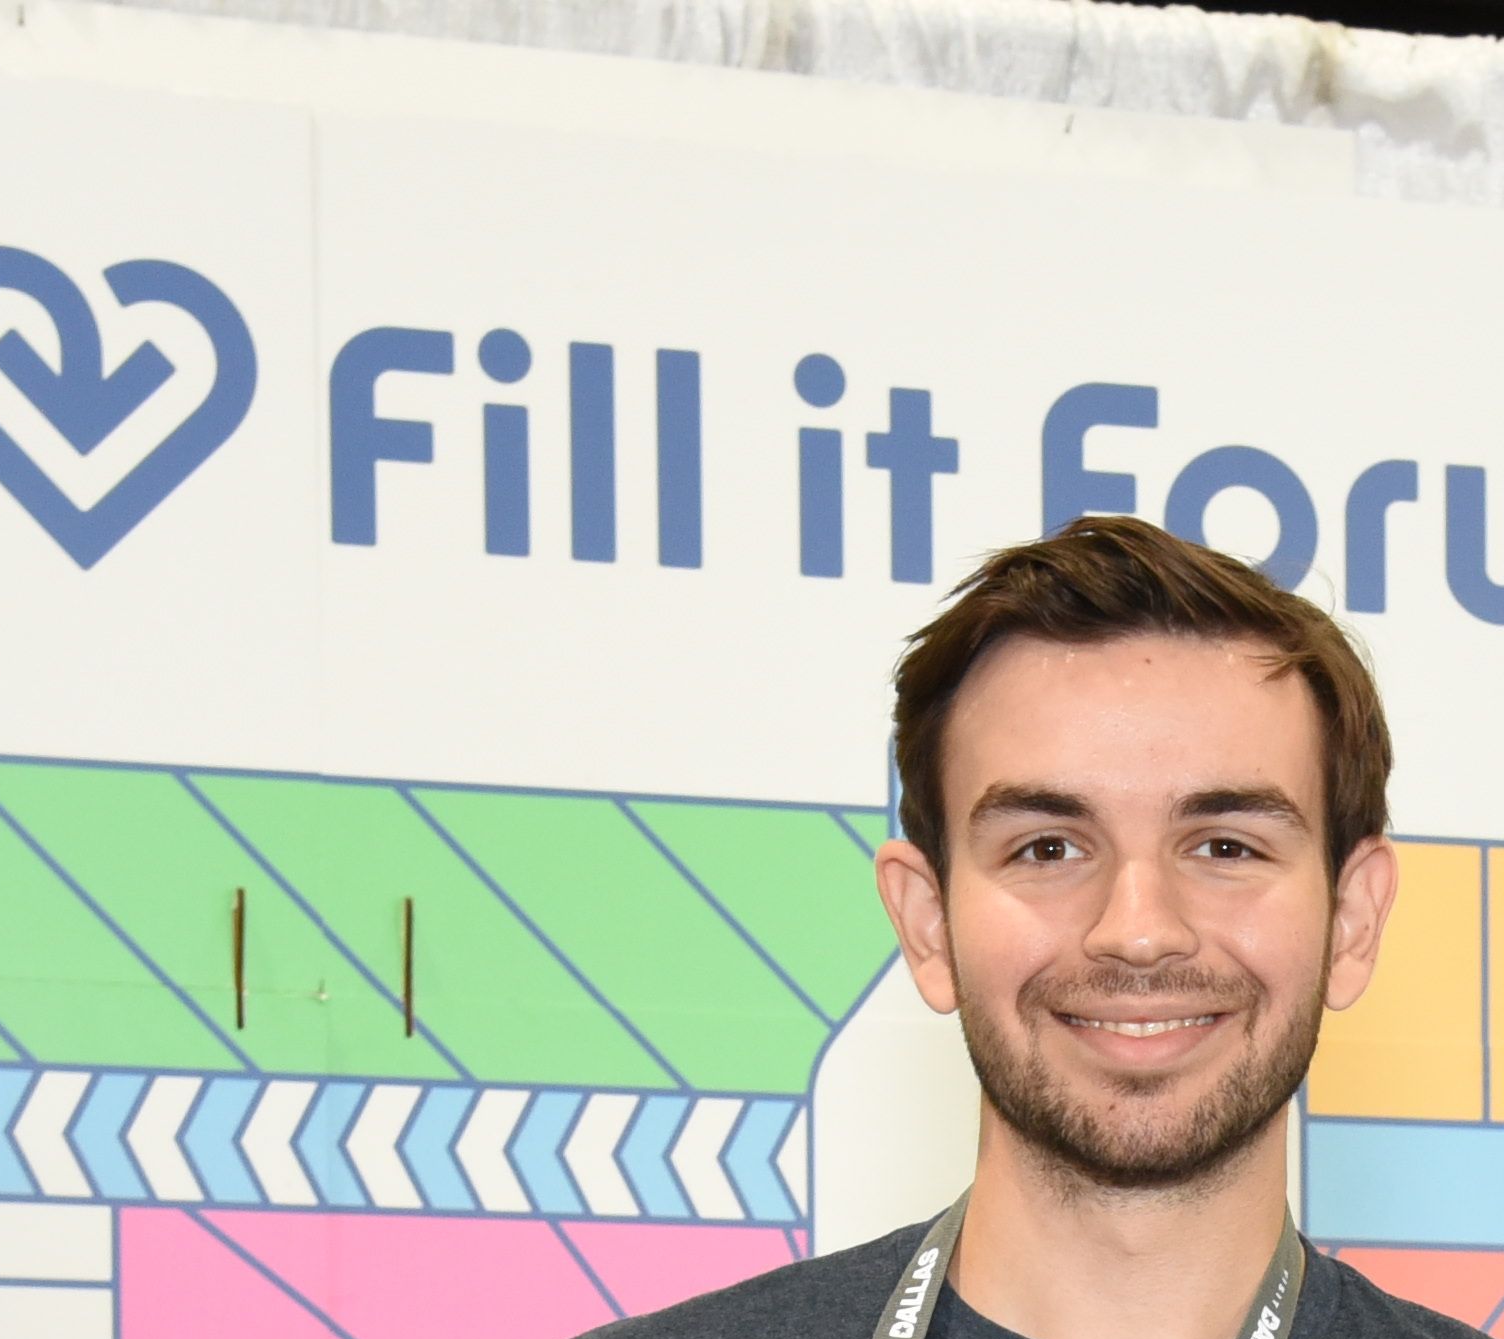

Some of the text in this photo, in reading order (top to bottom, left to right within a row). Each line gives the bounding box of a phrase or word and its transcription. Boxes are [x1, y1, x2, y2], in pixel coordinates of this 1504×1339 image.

[327, 324, 704, 572] Fill
[792, 352, 962, 586] it
[888, 1247, 939, 1339] DALLAS
